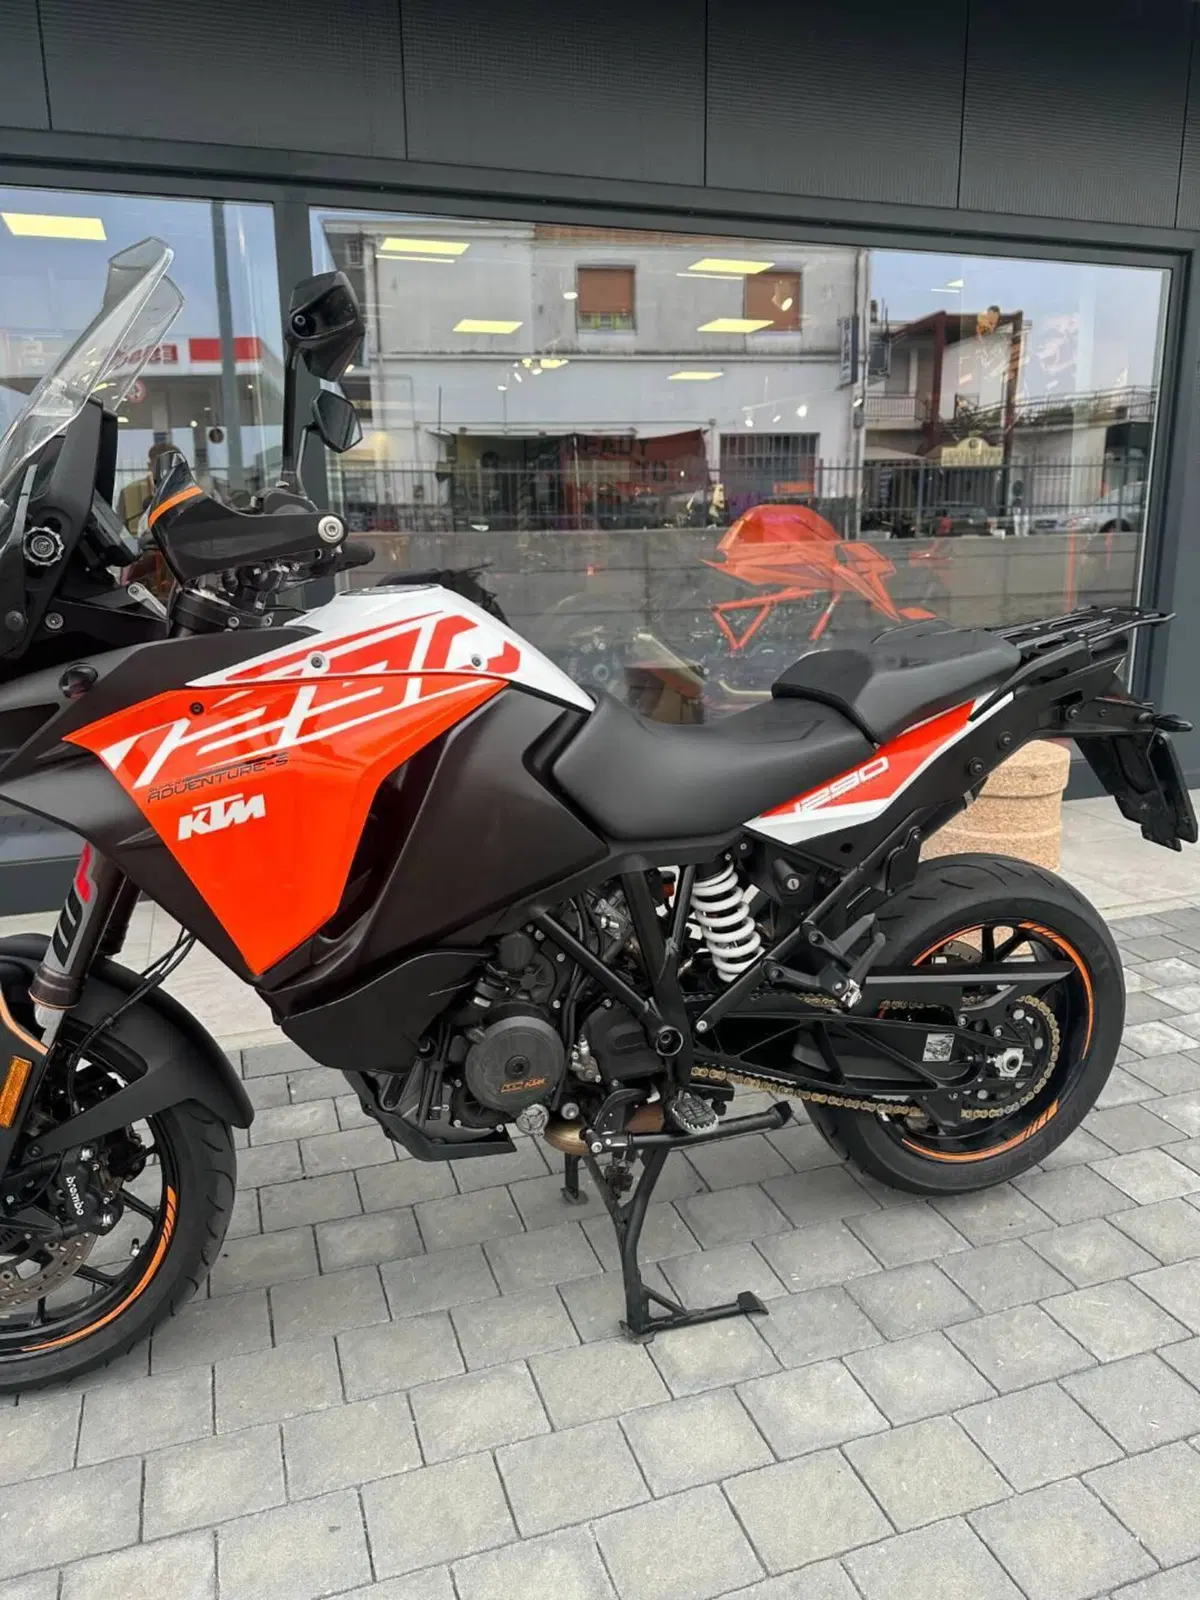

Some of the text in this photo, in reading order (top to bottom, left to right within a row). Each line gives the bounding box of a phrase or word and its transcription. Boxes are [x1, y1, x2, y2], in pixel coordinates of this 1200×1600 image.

[794, 756, 889, 814] 1290
[178, 793, 267, 841] KTM
[65, 1175, 84, 1216] brembo
